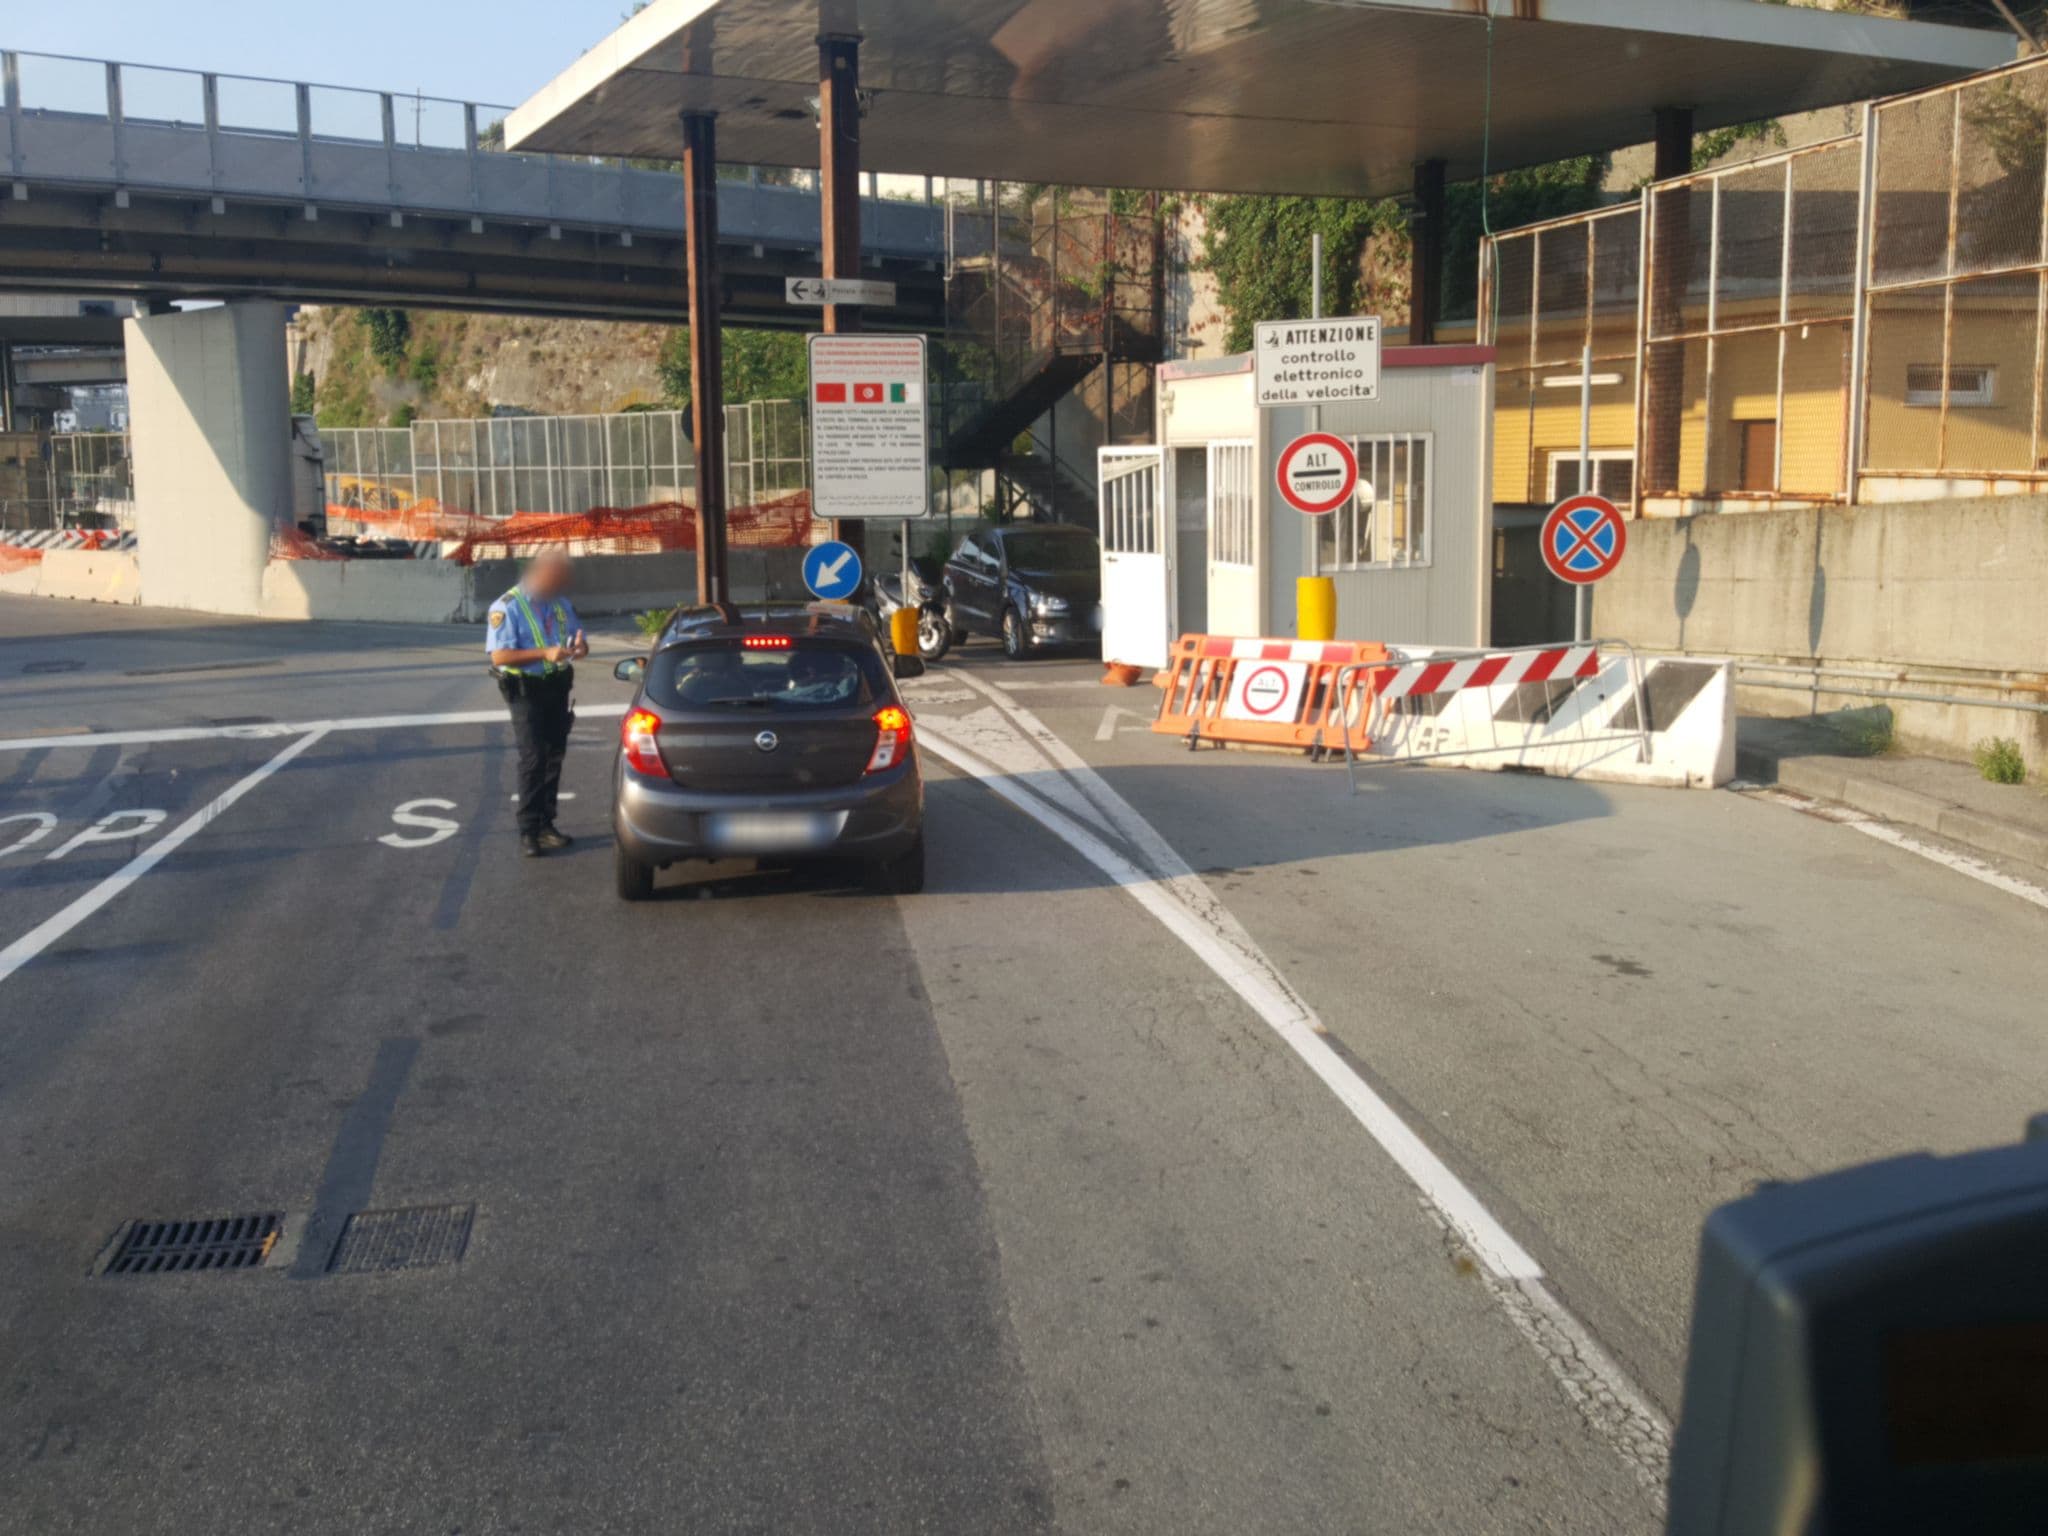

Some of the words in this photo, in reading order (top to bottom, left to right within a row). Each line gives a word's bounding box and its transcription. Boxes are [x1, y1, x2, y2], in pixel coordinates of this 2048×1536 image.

[1286, 326, 1375, 345] ATTENZIONE
[1281, 348, 1356, 365] controllo
[1273, 367, 1364, 383] elettronico
[1262, 387, 1298, 401] della
[1306, 452, 1328, 468] ALT
[1294, 478, 1341, 493] CONTROLLO
